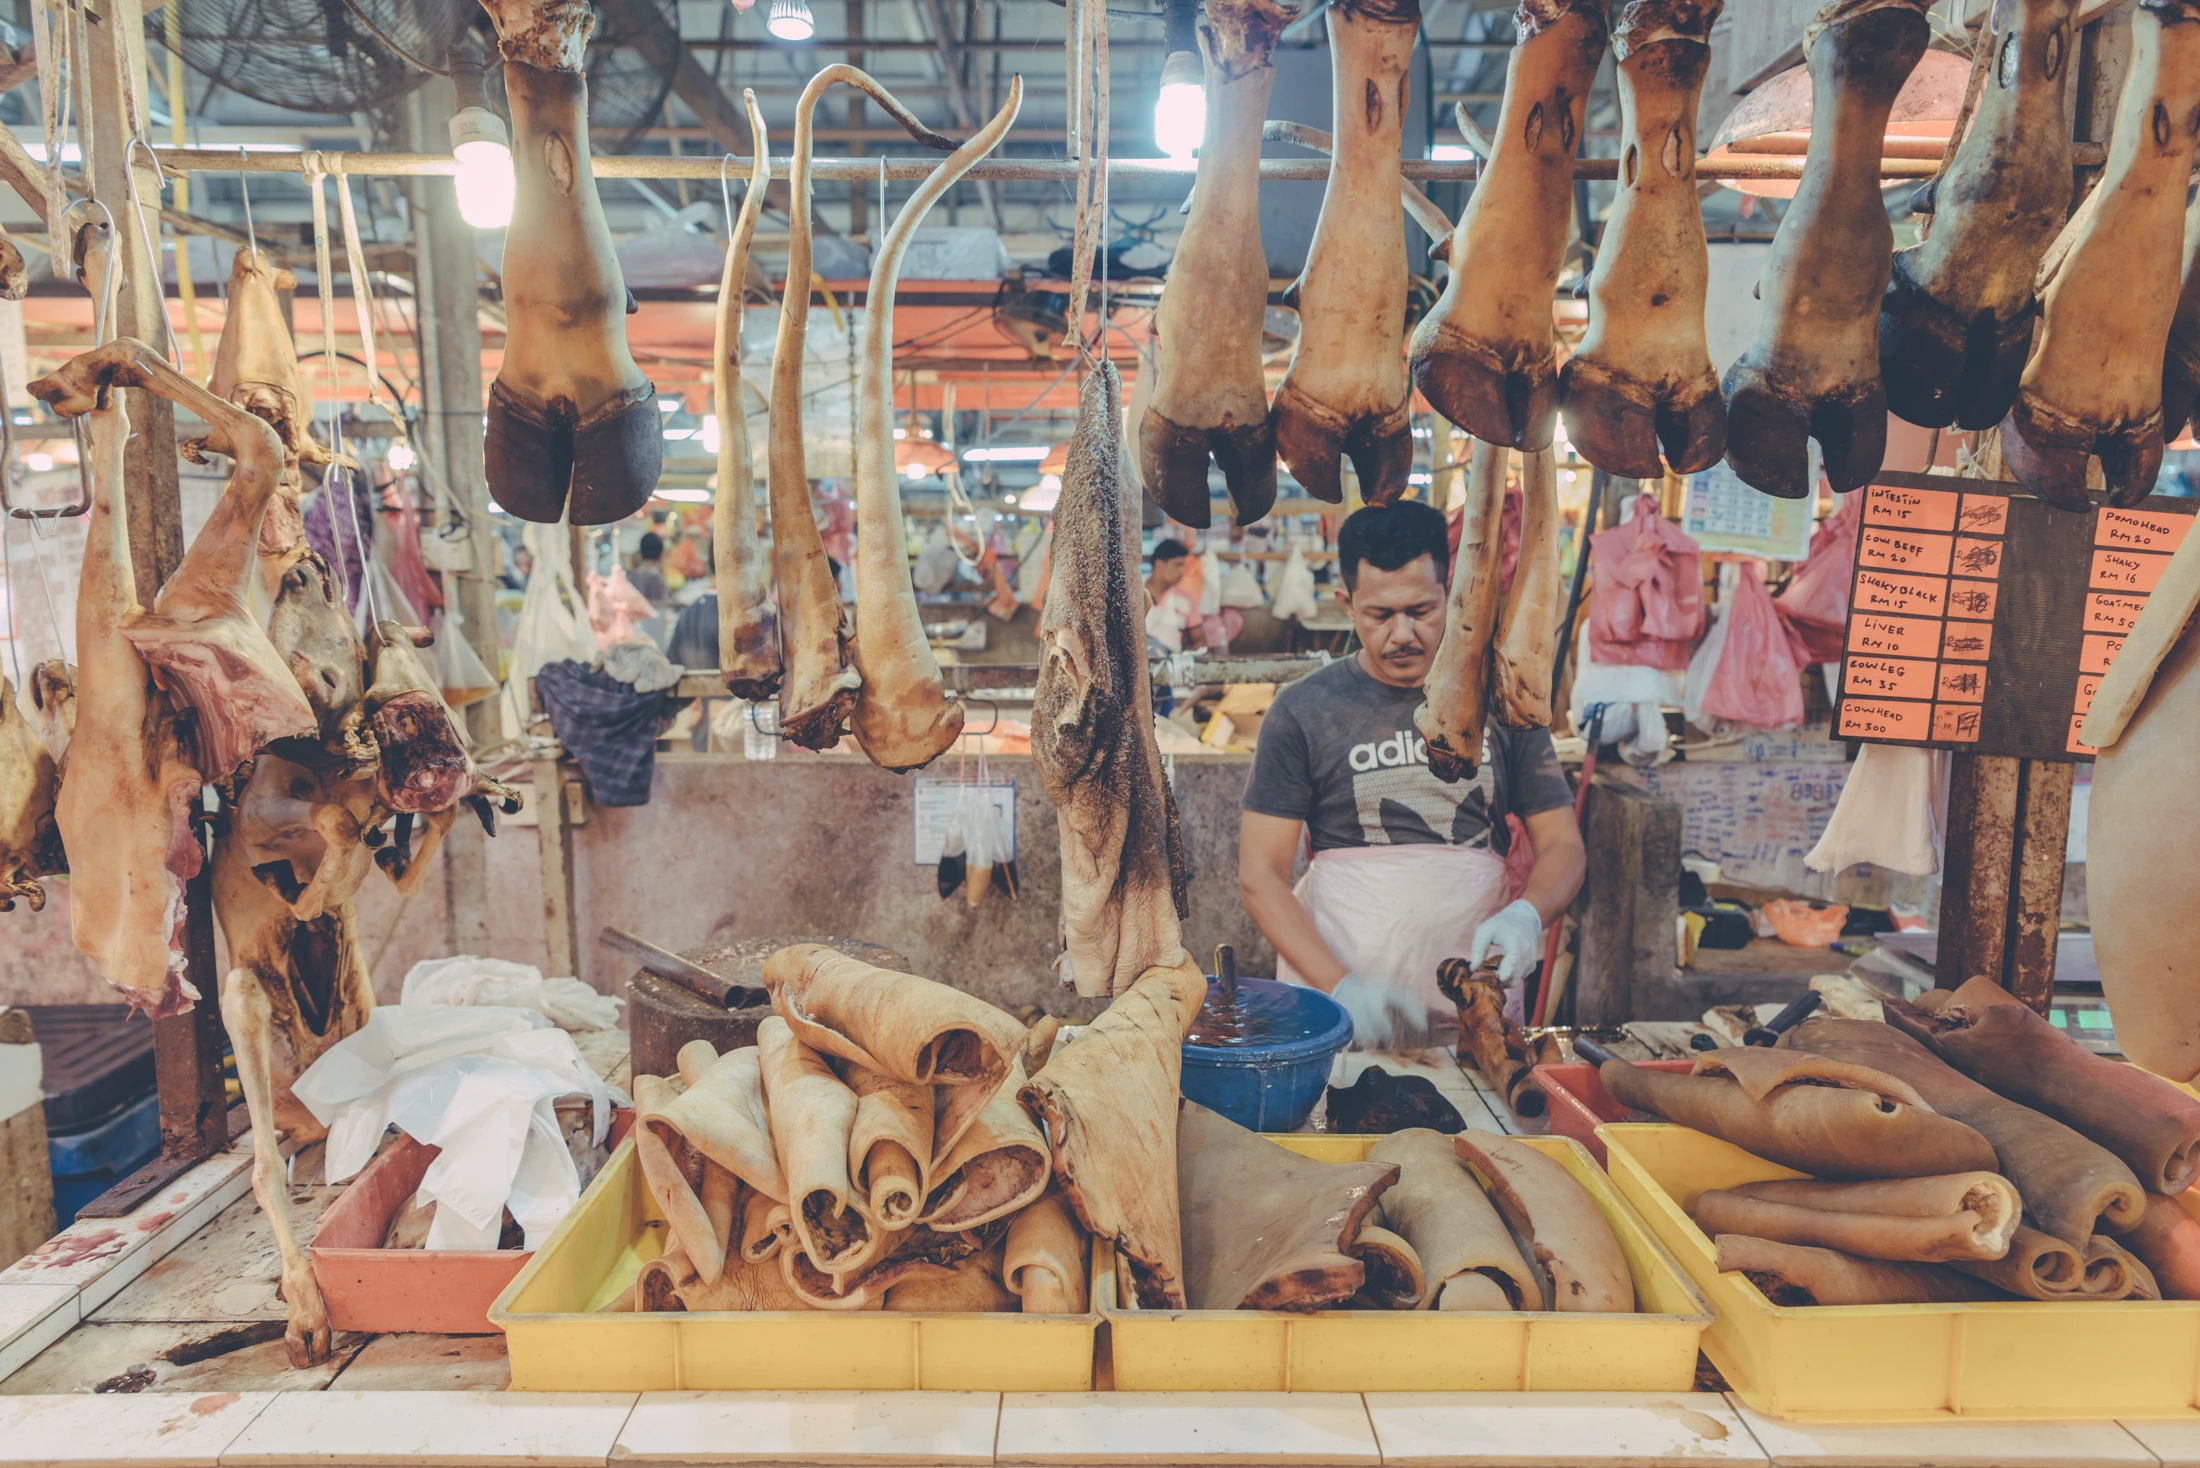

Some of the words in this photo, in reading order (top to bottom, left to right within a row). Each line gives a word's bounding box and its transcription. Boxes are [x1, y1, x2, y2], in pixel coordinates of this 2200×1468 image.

[1873, 505, 1892, 517] RM
[1898, 508, 1912, 519] 15
[2110, 529, 2131, 543] RM
[2134, 536, 2151, 545] 20
[1865, 535, 1891, 545] COW
[1894, 540, 1924, 557] BEEF
[1868, 549, 1885, 559] RM
[1891, 554, 1906, 563] 20
[2104, 555, 2141, 571] SHAKY
[2100, 571, 2118, 580] RM
[2125, 573, 2136, 584] 16
[1870, 594, 1890, 606] RM
[1894, 600, 1908, 609] 15
[2094, 612, 2115, 624] RM
[2117, 617, 2135, 628] 50
[1862, 637, 1882, 648] RM
[1887, 643, 1899, 651] 10
[1852, 675, 1872, 687] RM
[1879, 680, 1897, 691] 35
[1845, 721, 1861, 729] RM
[1865, 723, 1886, 733] 300
